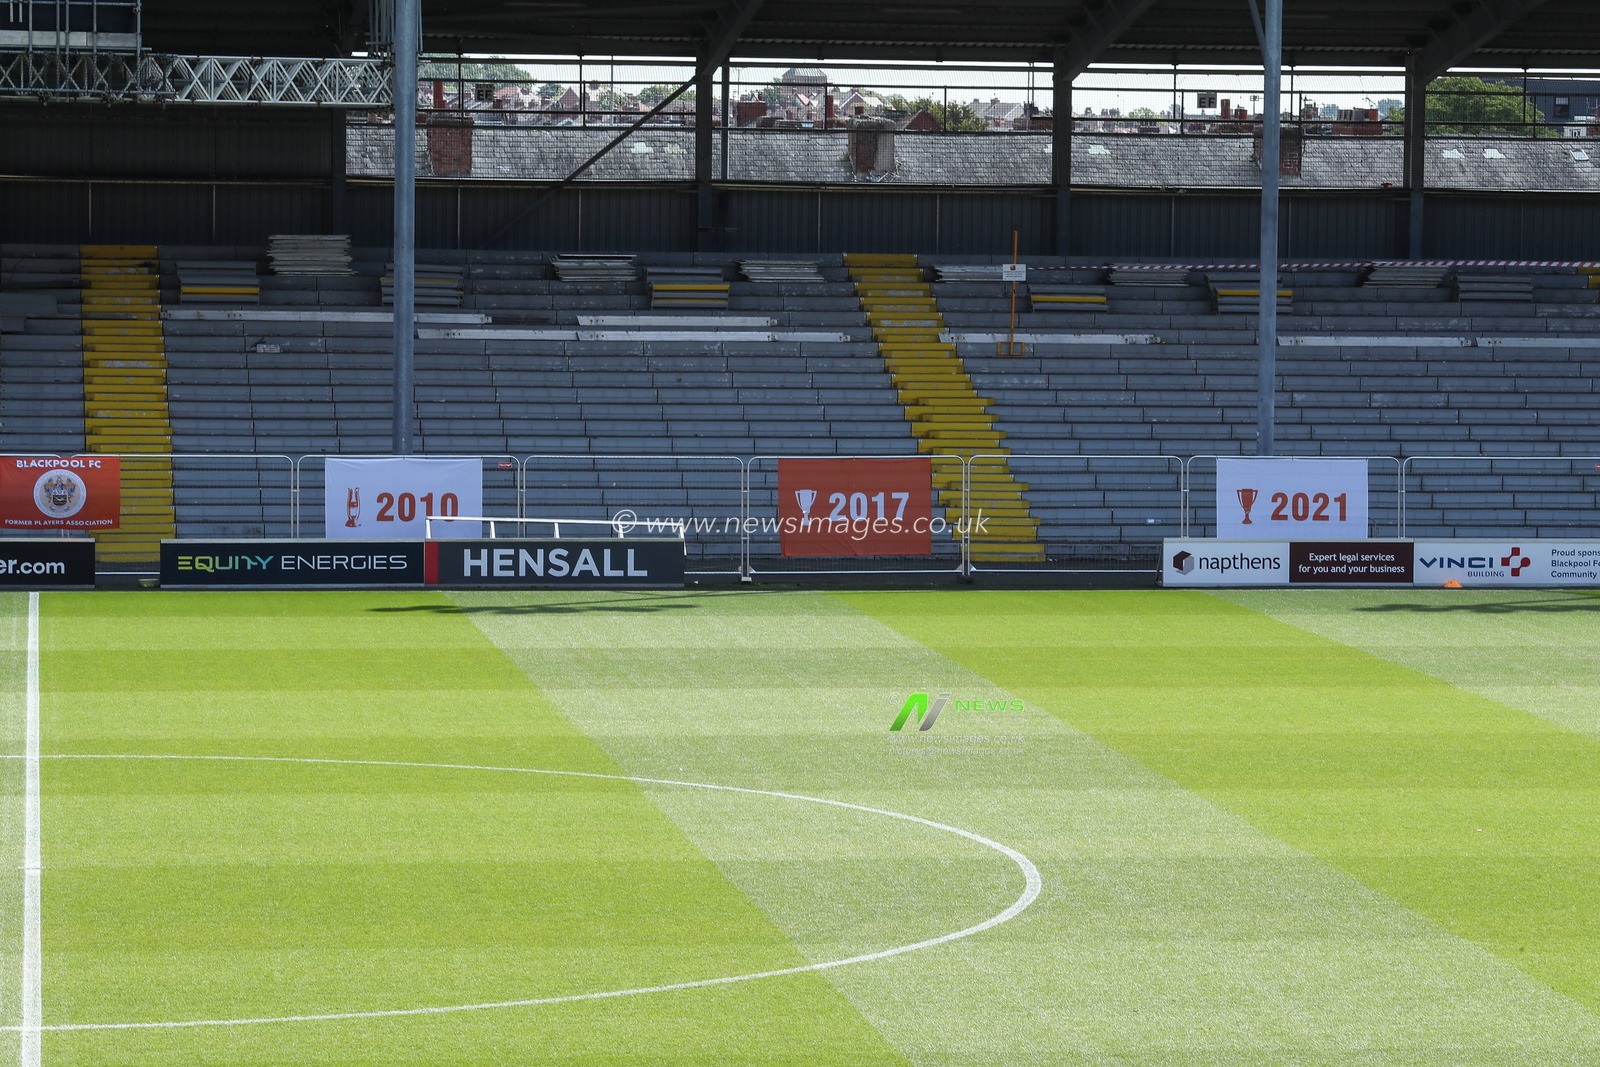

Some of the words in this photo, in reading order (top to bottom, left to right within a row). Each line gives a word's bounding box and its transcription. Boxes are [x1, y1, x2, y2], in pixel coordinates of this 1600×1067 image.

[16, 459, 86, 469] BLACKPOOL
[88, 460, 102, 469] FC
[376, 492, 459, 522] 2010
[828, 492, 910, 522] 2017
[1270, 492, 1347, 522] 2021
[66, 519, 113, 527] ASSOCIATION
[1308, 552, 1338, 564] Expert
[1339, 552, 1359, 564] legal
[1360, 552, 1396, 562] services
[1551, 549, 1576, 557] Proud
[177, 555, 275, 573] EQUITY
[280, 555, 409, 570] ENERGIES
[463, 548, 649, 577] HENSALL
[1199, 553, 1282, 575] napthens
[1419, 557, 1494, 569] VINCI
[1551, 559, 1591, 569] Blackpool
[1298, 564, 1311, 573] for
[1313, 565, 1329, 575] you
[1330, 564, 1347, 573] and
[1348, 565, 1368, 575] your
[1369, 564, 1405, 573] business
[1550, 570, 1598, 580] Community
